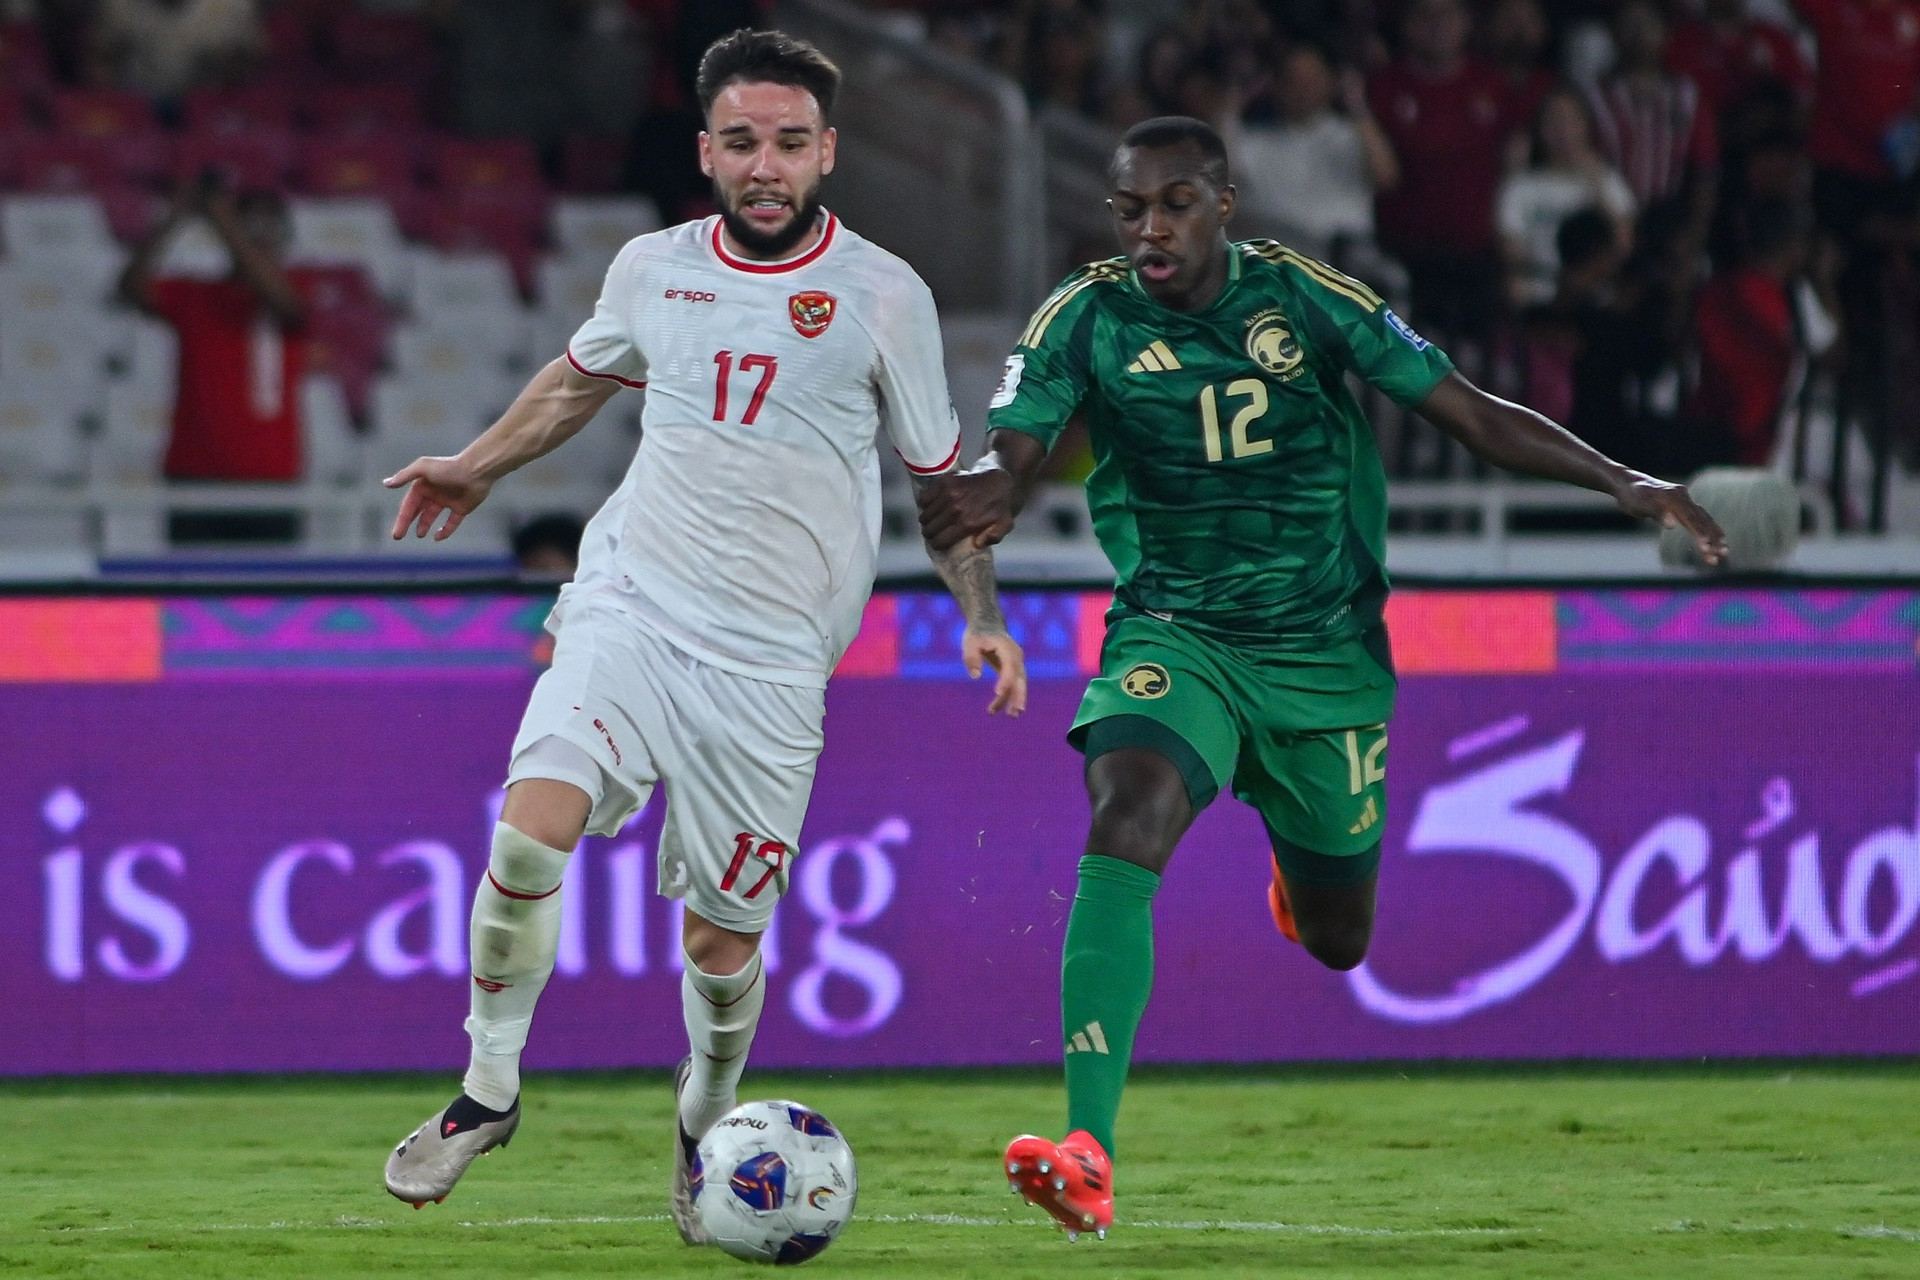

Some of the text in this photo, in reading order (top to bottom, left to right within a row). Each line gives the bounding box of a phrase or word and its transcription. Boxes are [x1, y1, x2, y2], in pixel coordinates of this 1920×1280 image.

[664, 289, 716, 303] erspo
[712, 350, 778, 425] 17
[1200, 378, 1274, 463] 12
[1346, 722, 1388, 796] 12
[43, 788, 188, 982] is
[720, 832, 787, 899] 17
